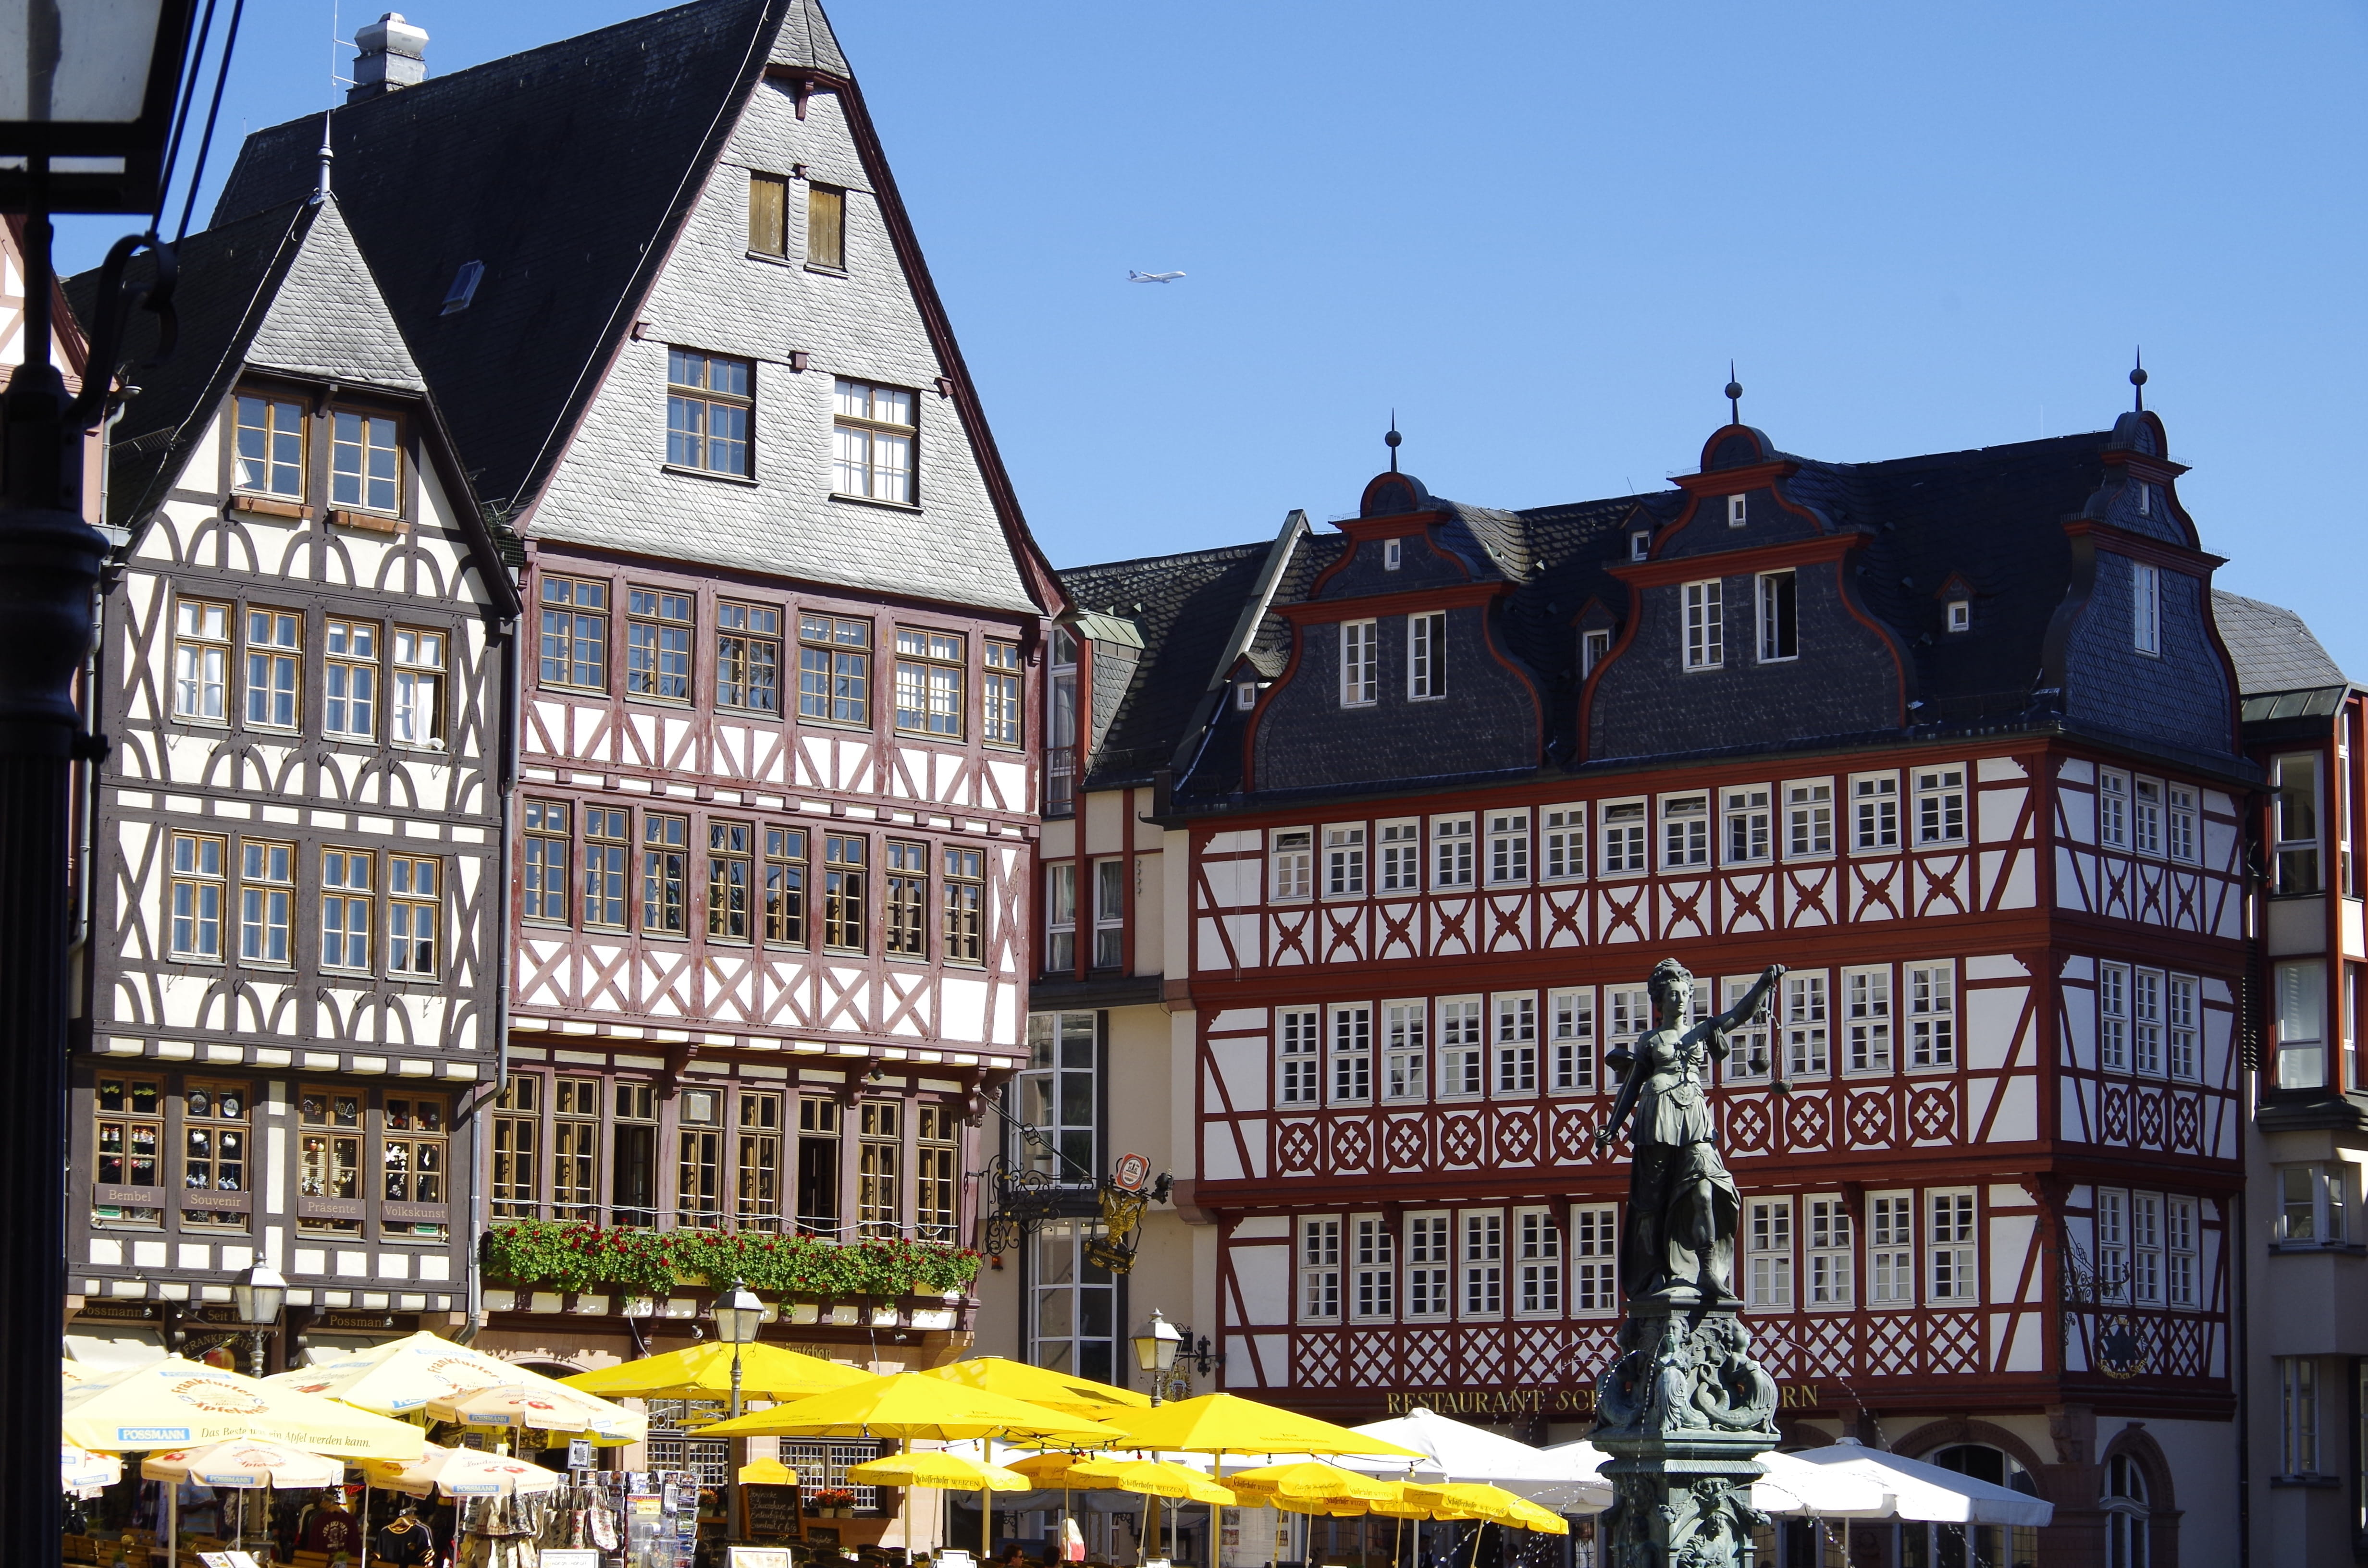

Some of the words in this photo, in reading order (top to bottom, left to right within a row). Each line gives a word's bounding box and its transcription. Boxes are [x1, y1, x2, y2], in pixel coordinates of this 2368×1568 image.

[109, 1189, 151, 1202] Bembel
[191, 1194, 242, 1207] Souvenir
[308, 1201, 357, 1214] Präsente
[385, 1206, 446, 1219] Volkskunst
[208, 1310, 228, 1322] Seit
[171, 1378, 256, 1397] Frankfurter
[190, 1401, 270, 1415] Apfelwein
[1387, 1390, 1544, 1414] RESTAURANT
[123, 1429, 186, 1440] POSSMANN
[201, 1428, 219, 1438] Das
[223, 1427, 247, 1436] Beste
[284, 1431, 307, 1444] Apfel
[309, 1435, 342, 1446] werden
[345, 1436, 371, 1447] kann.
[210, 1475, 251, 1483] POSSMANN
[916, 1471, 949, 1485] Schöfferhofer
[951, 1478, 979, 1487] WEIZEN
[1156, 1485, 1184, 1493] WEIZEN
